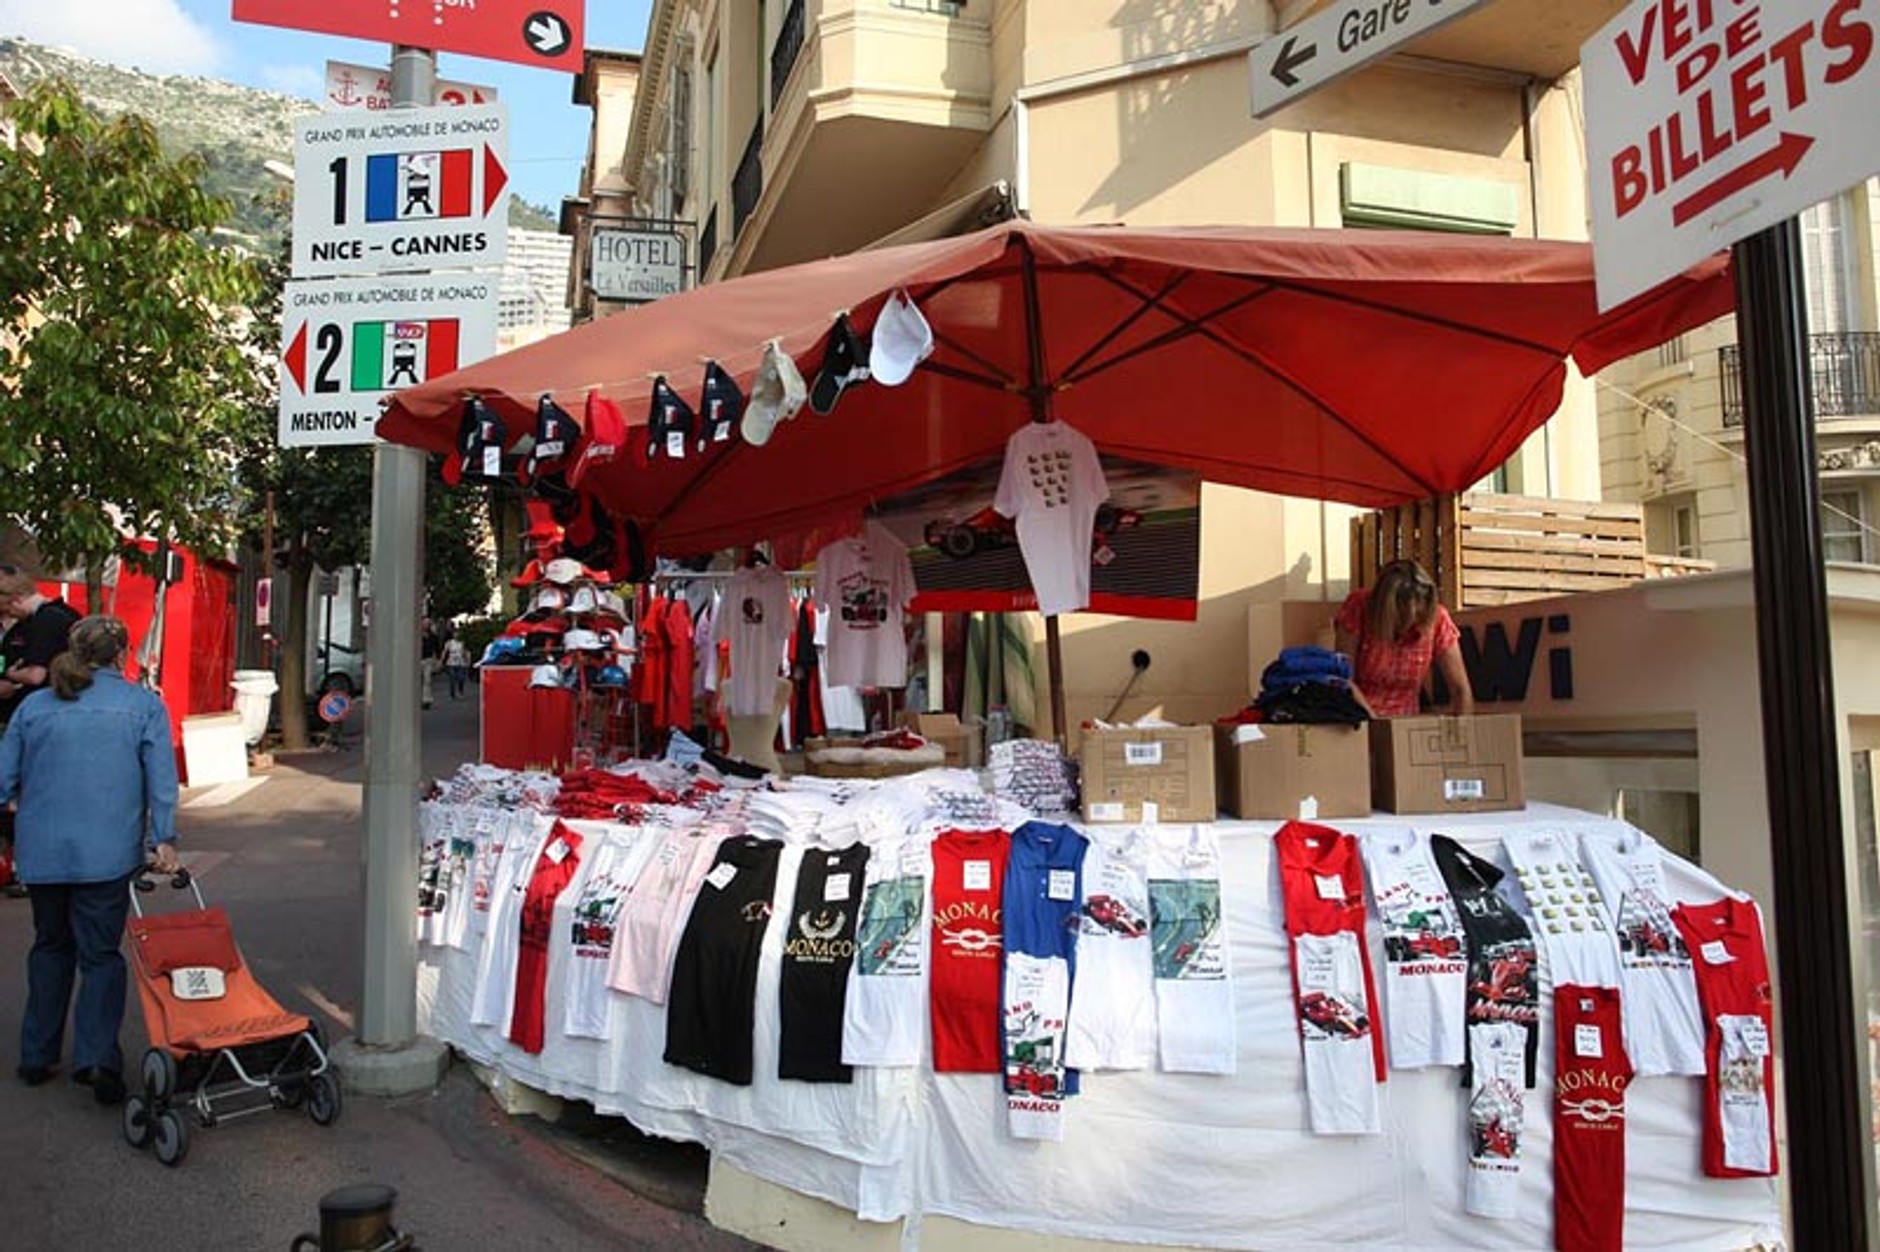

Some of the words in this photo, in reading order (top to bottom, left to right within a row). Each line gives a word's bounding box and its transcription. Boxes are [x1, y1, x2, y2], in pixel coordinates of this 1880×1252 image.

[1337, 0, 1410, 53] Gare
[1675, 6, 1763, 96] DE
[1611, 0, 1874, 220] BILLETS
[305, 129, 342, 144] GRAND
[346, 128, 366, 142] PRIX
[370, 122, 431, 141] AUTOMOBILE
[435, 120, 448, 136] DE
[451, 118, 500, 134] MONACO
[328, 156, 348, 226] 1
[311, 240, 364, 262] NICE
[390, 232, 488, 256] CANNES
[598, 235, 676, 267] HOTEL
[293, 292, 329, 307] GRAND
[333, 291, 352, 305] PRIX
[357, 287, 418, 303] AUTOMOBILE
[421, 286, 435, 302] DE
[438, 285, 488, 300] MONACO
[313, 322, 343, 394] 2
[290, 410, 356, 432] MENTON
[934, 901, 1002, 929] MONAC
[786, 939, 853, 958] MONACO
[1556, 1068, 1626, 1099] MONAC
[1008, 1101, 1060, 1113] ONACO
